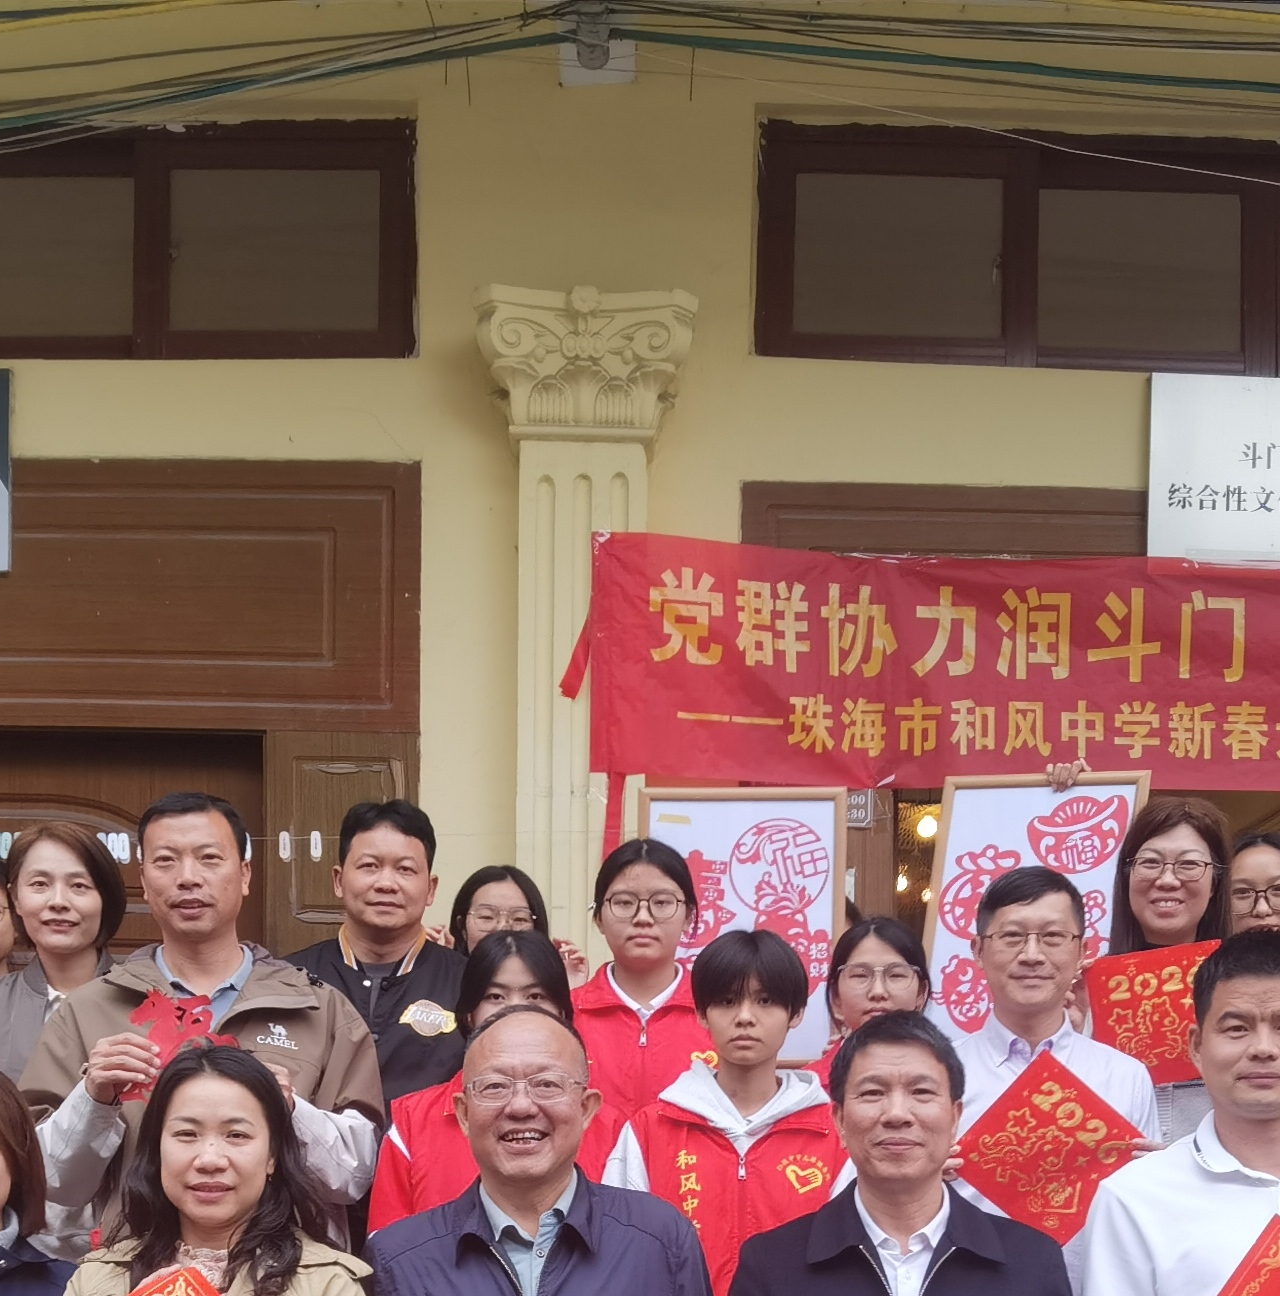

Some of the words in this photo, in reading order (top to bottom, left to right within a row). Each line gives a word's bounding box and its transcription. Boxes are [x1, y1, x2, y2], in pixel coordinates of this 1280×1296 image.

[649, 566, 1245, 684] 党群协力润斗门
[256, 1035, 299, 1050] CAMEL
